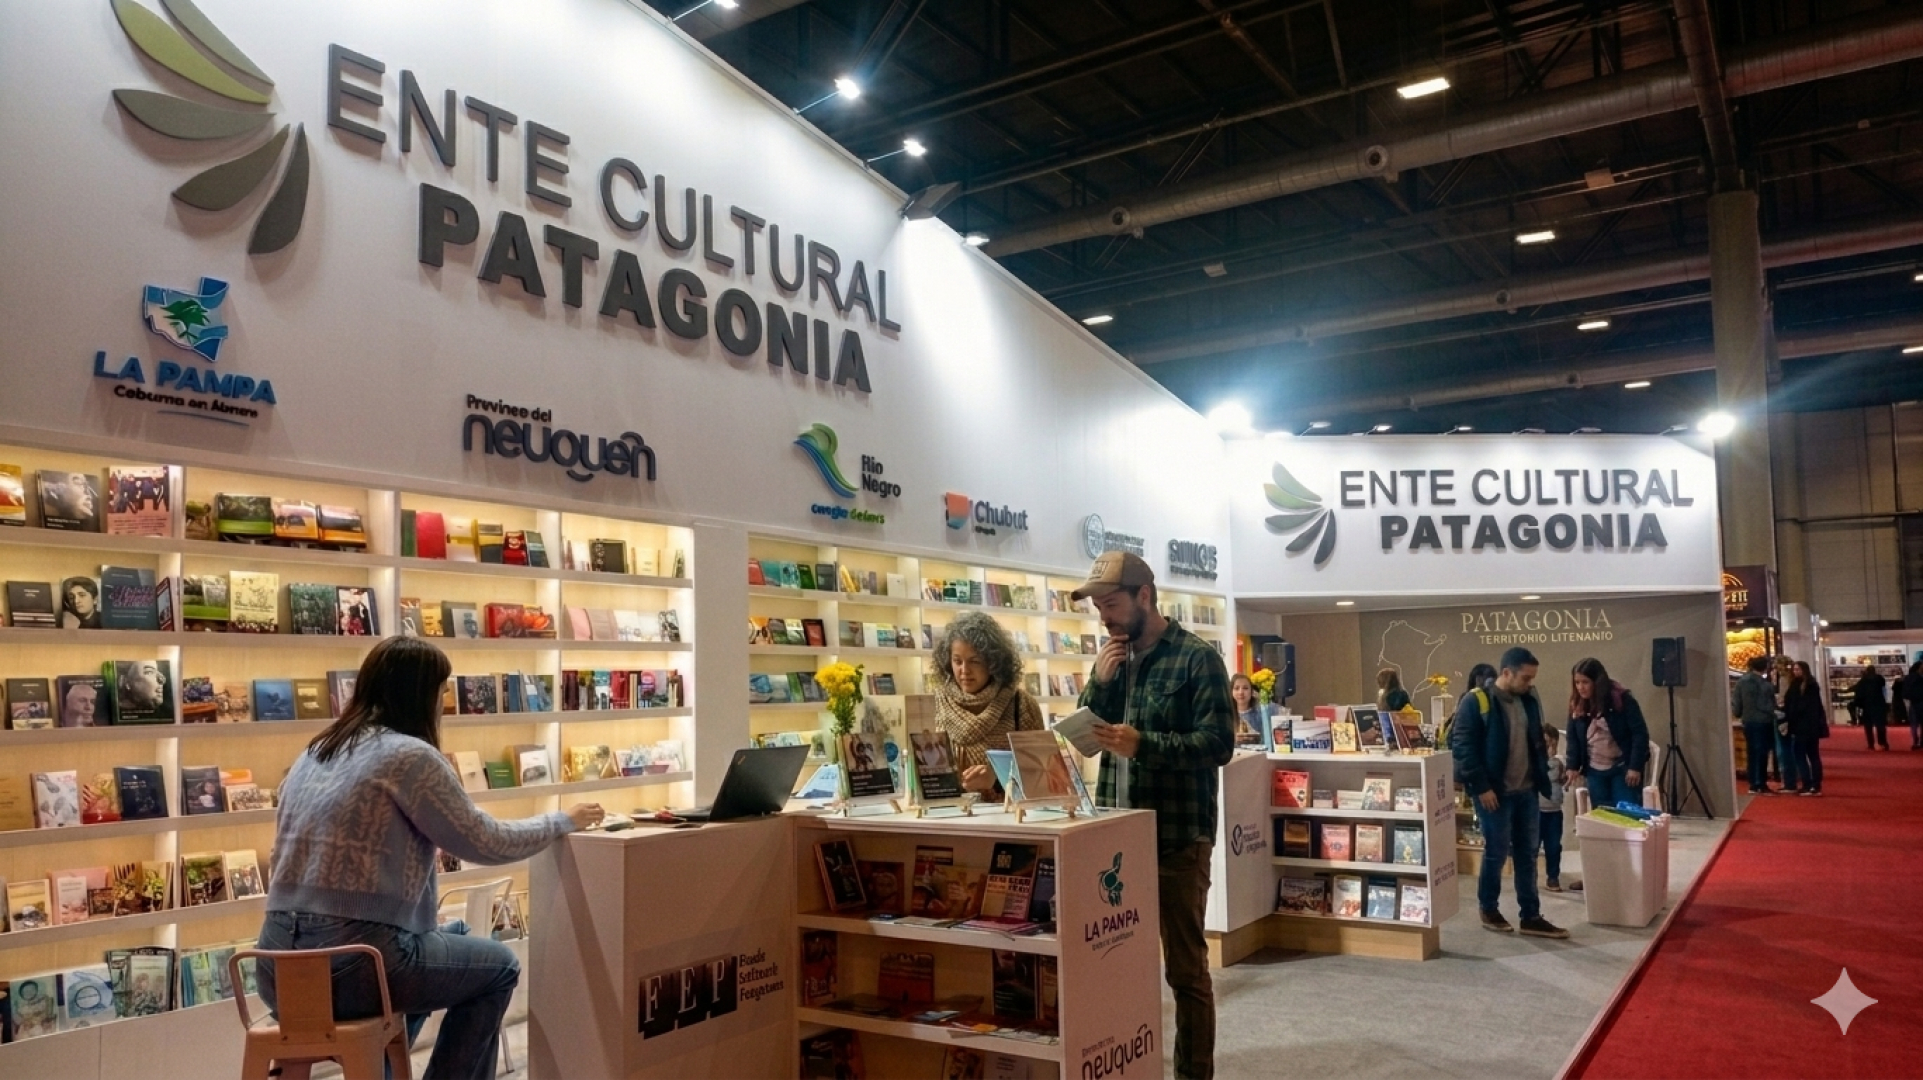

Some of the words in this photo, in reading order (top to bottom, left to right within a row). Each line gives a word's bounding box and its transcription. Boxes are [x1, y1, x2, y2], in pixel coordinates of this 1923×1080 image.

[327, 42, 571, 208] ENTE
[600, 156, 901, 332] CULTURAL
[418, 182, 872, 393] PATAGONIA
[93, 350, 146, 384] LA
[155, 360, 277, 405] PAMPA
[861, 473, 902, 498] Negro
[1339, 469, 1456, 508] ENTE
[1471, 469, 1694, 506] CULTURAL
[974, 500, 1029, 531] Chubut
[1380, 513, 1669, 550] PATAGONIA
[1460, 608, 1612, 634] PATAGONIA
[1479, 632, 1547, 645] TERRITORIO
[1084, 920, 1100, 942] LA
